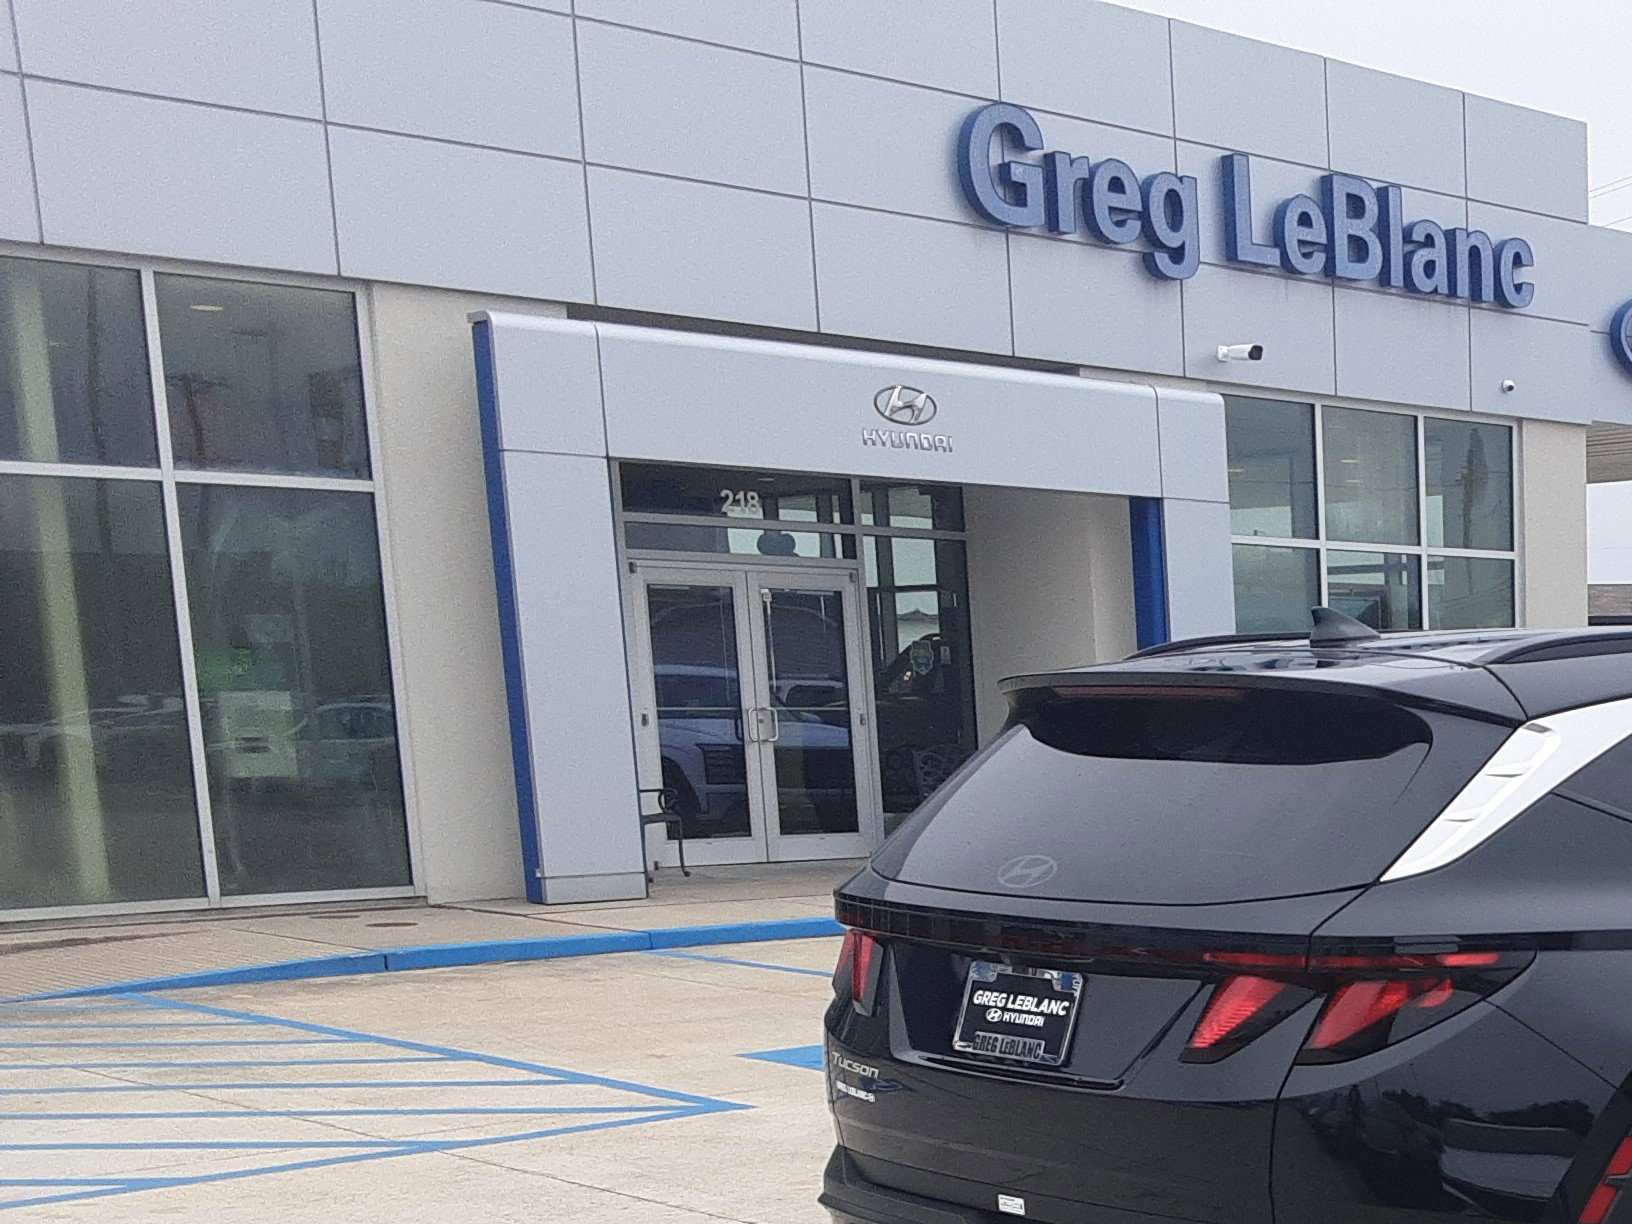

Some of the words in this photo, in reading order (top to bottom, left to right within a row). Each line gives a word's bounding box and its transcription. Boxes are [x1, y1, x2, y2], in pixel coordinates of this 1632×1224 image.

[957, 102, 1200, 280] Greg
[1222, 152, 1534, 308] LeBlanc
[862, 428, 953, 453] HYUNDAI
[720, 489, 760, 515] 218
[973, 990, 1008, 1007] GREG
[1006, 994, 1070, 1016] LEBLANC
[1002, 1011, 1046, 1027] HYUNDAI
[972, 1033, 999, 1053] GREG
